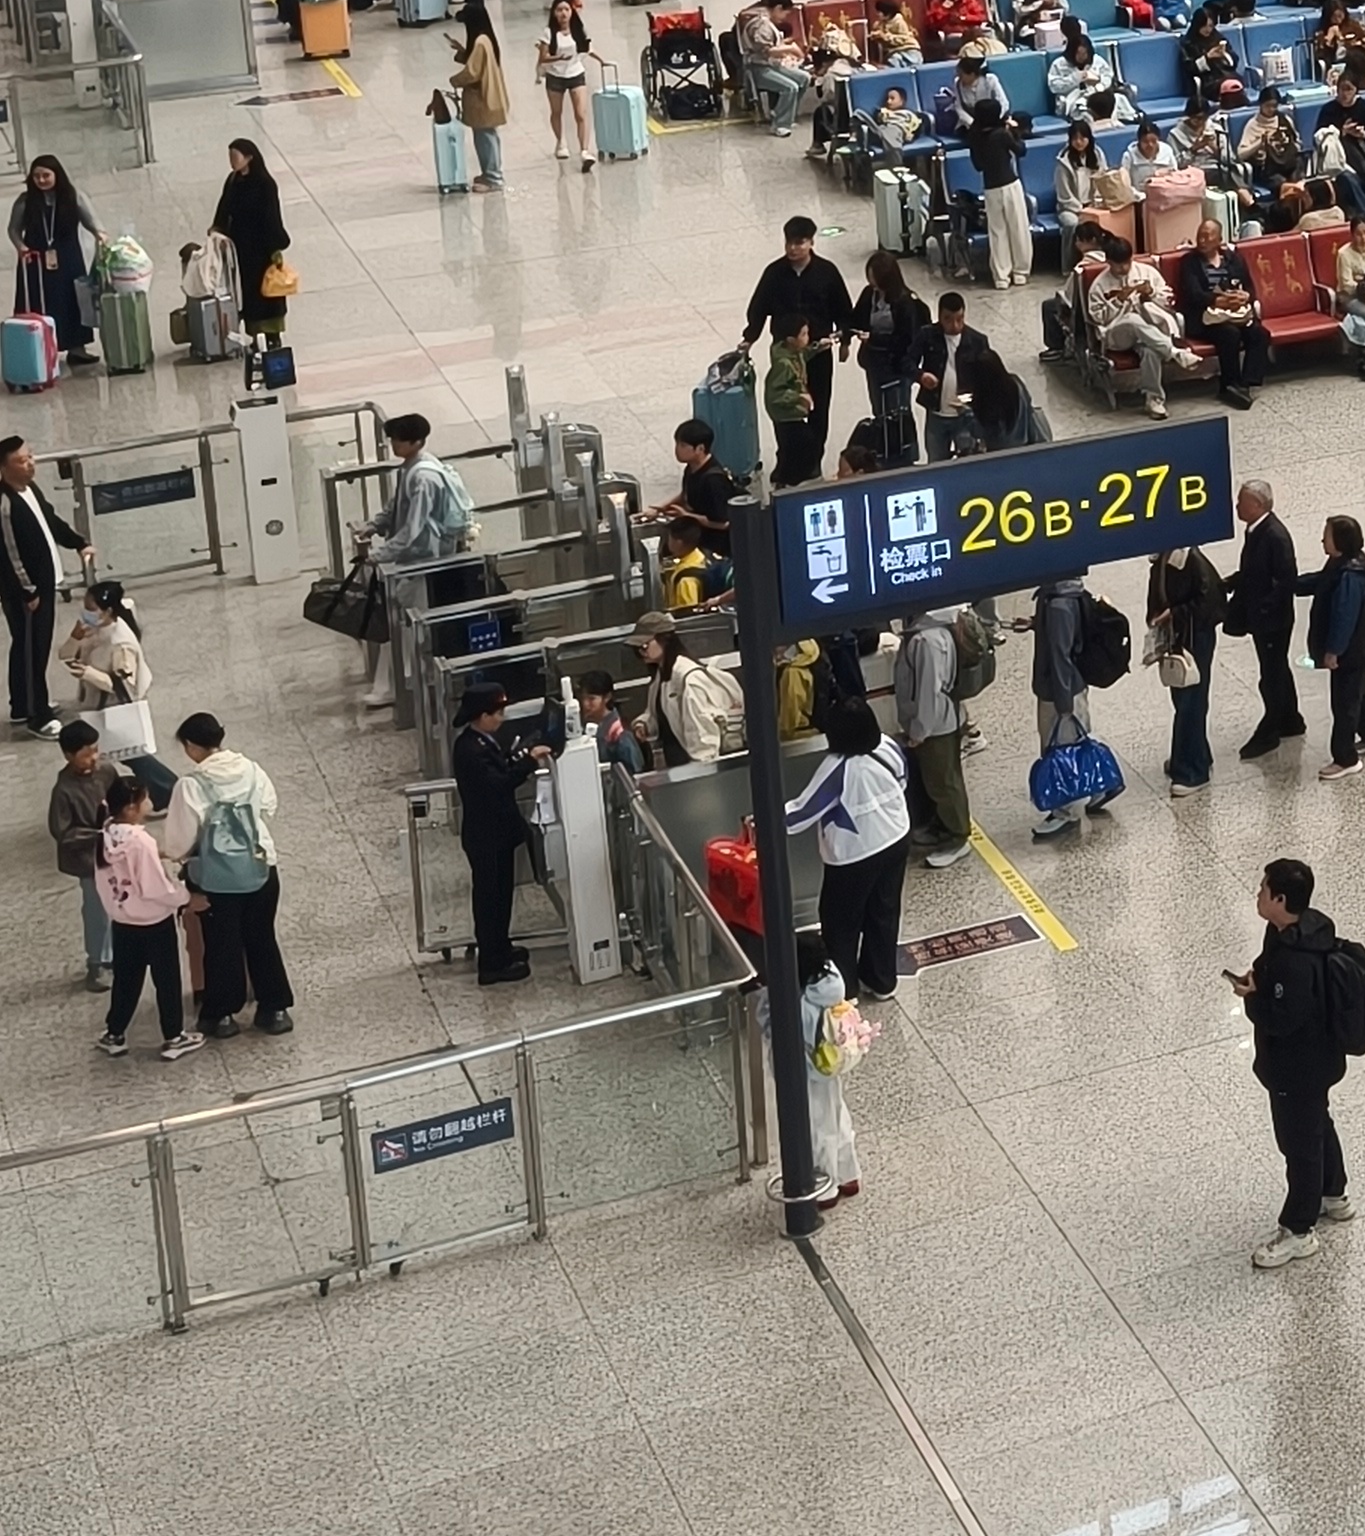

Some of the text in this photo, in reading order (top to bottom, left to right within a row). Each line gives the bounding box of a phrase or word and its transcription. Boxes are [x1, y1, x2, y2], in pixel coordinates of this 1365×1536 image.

[958, 463, 1208, 553] 26B·27B
[879, 538, 952, 574] 检票口
[891, 565, 943, 585] Check in
